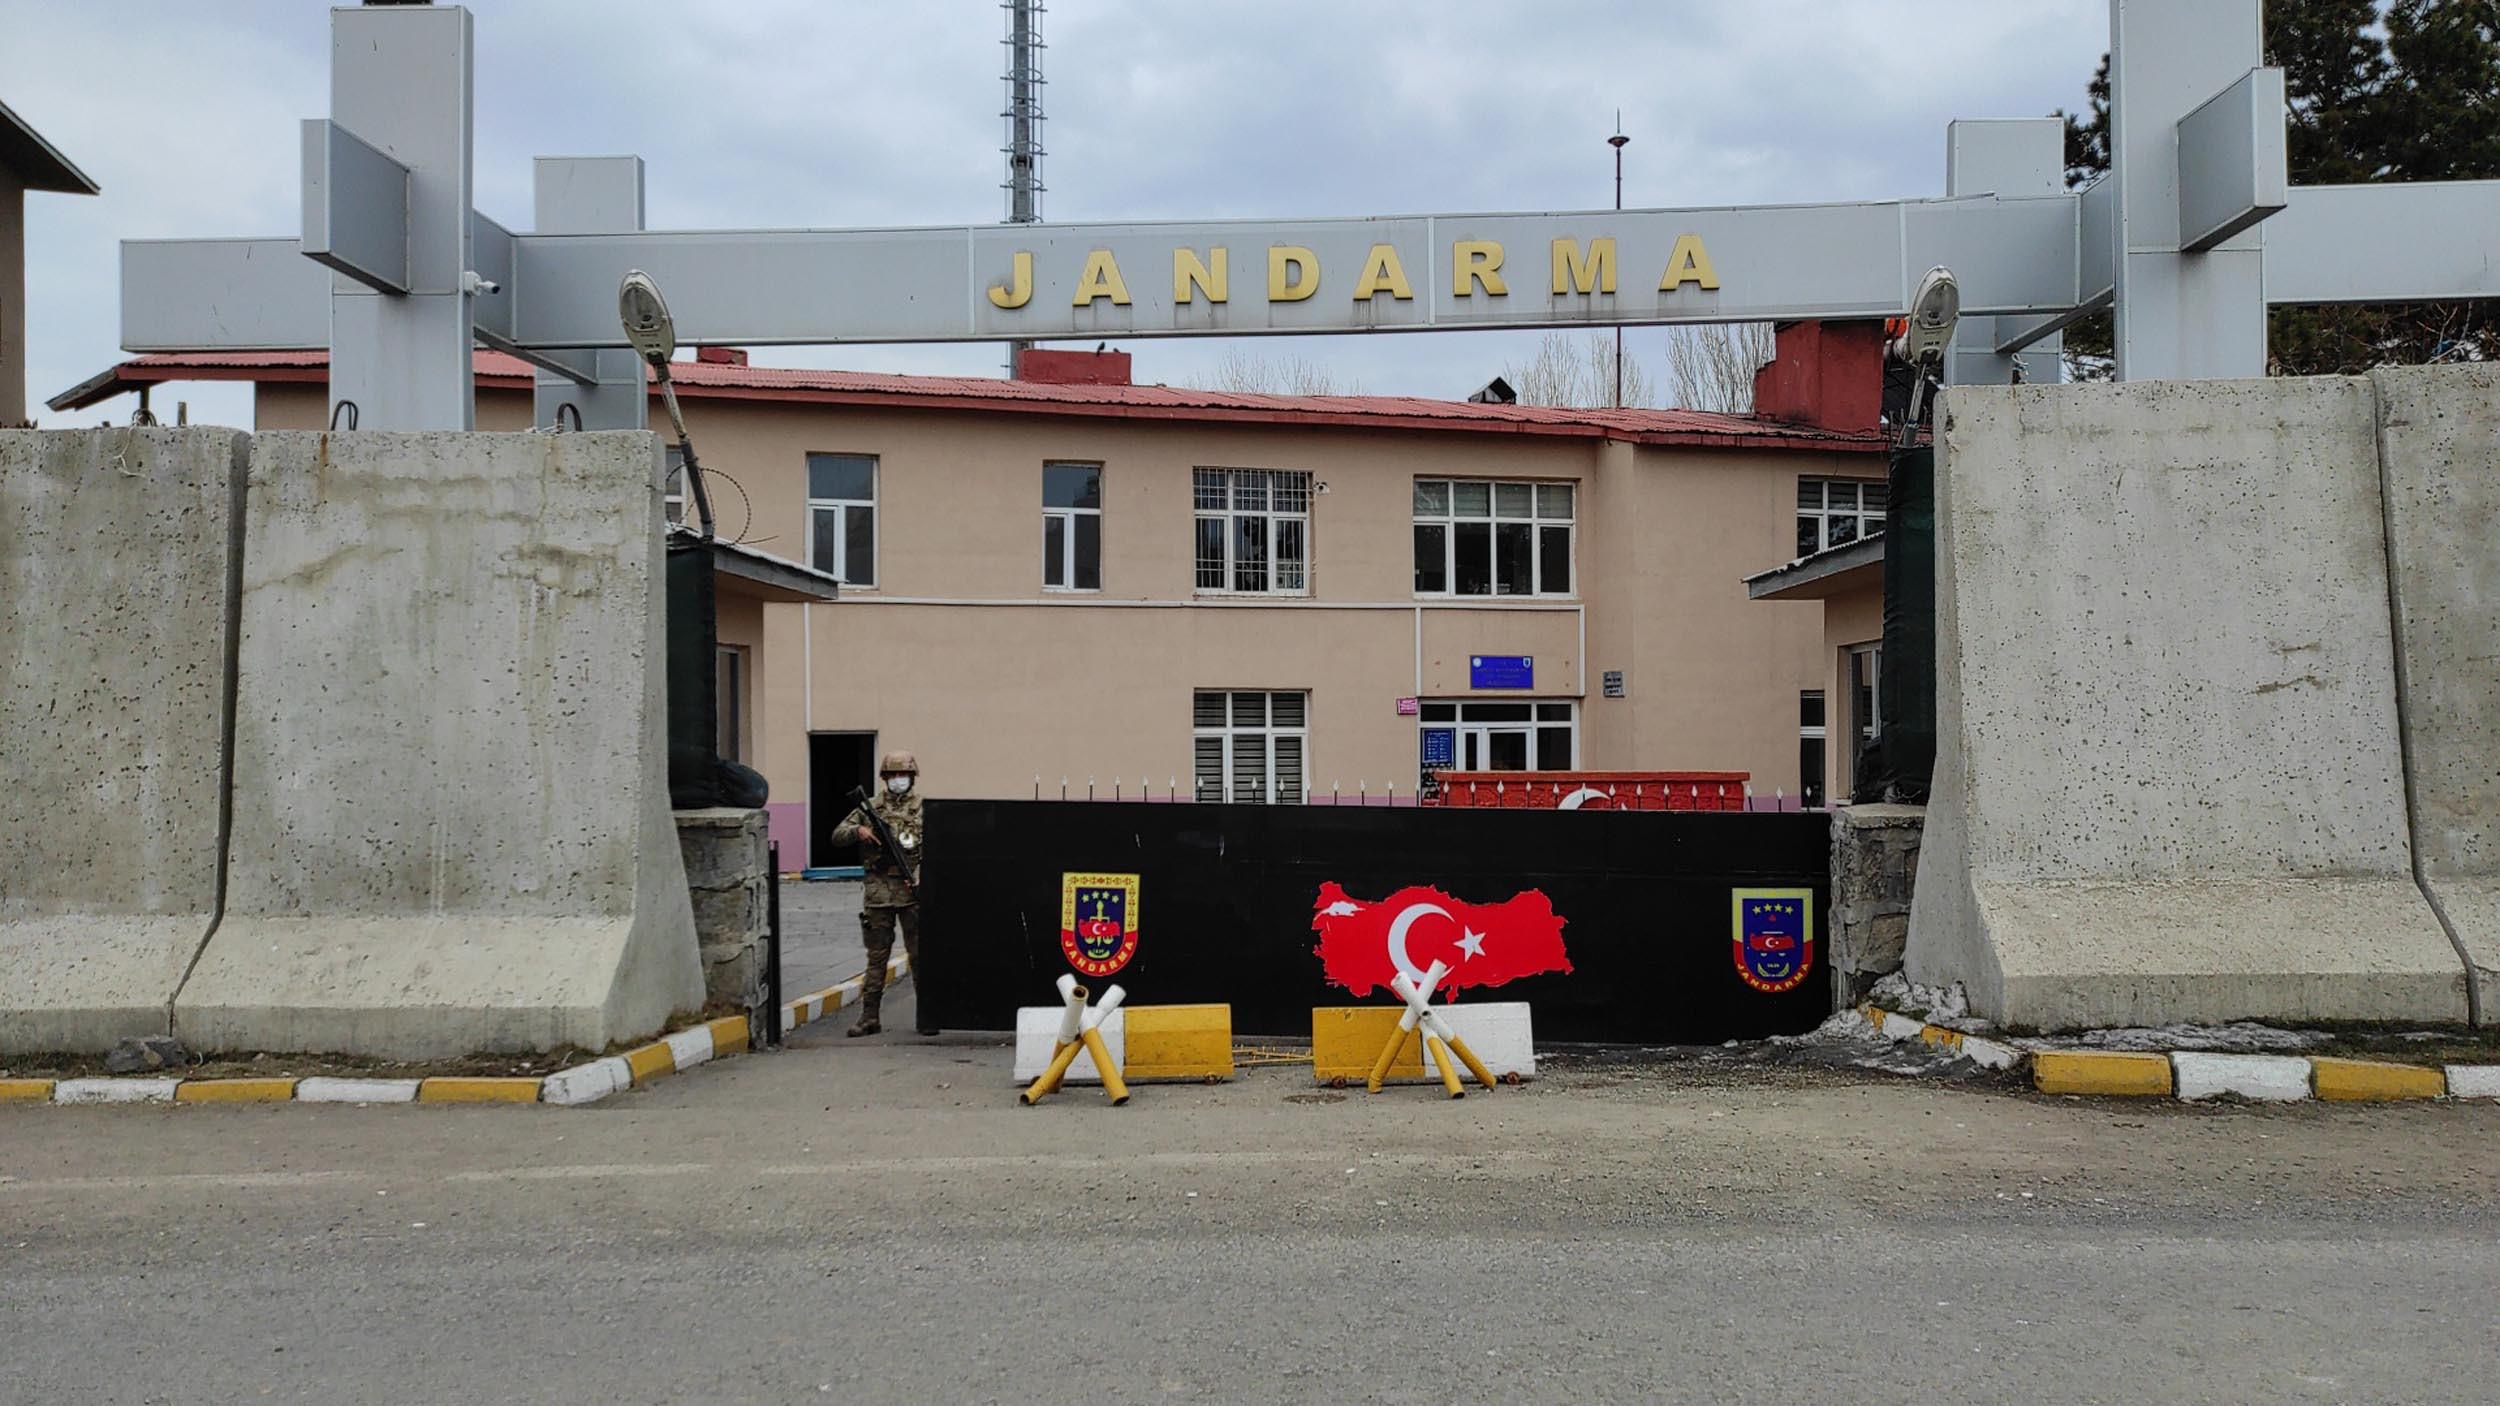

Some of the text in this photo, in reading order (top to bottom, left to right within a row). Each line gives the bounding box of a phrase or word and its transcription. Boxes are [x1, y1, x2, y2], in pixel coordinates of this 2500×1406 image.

[988, 234, 1721, 310] JANDARMA
[1065, 941, 1133, 973] JANDARMA
[1737, 963, 1808, 991] JANDARMA
